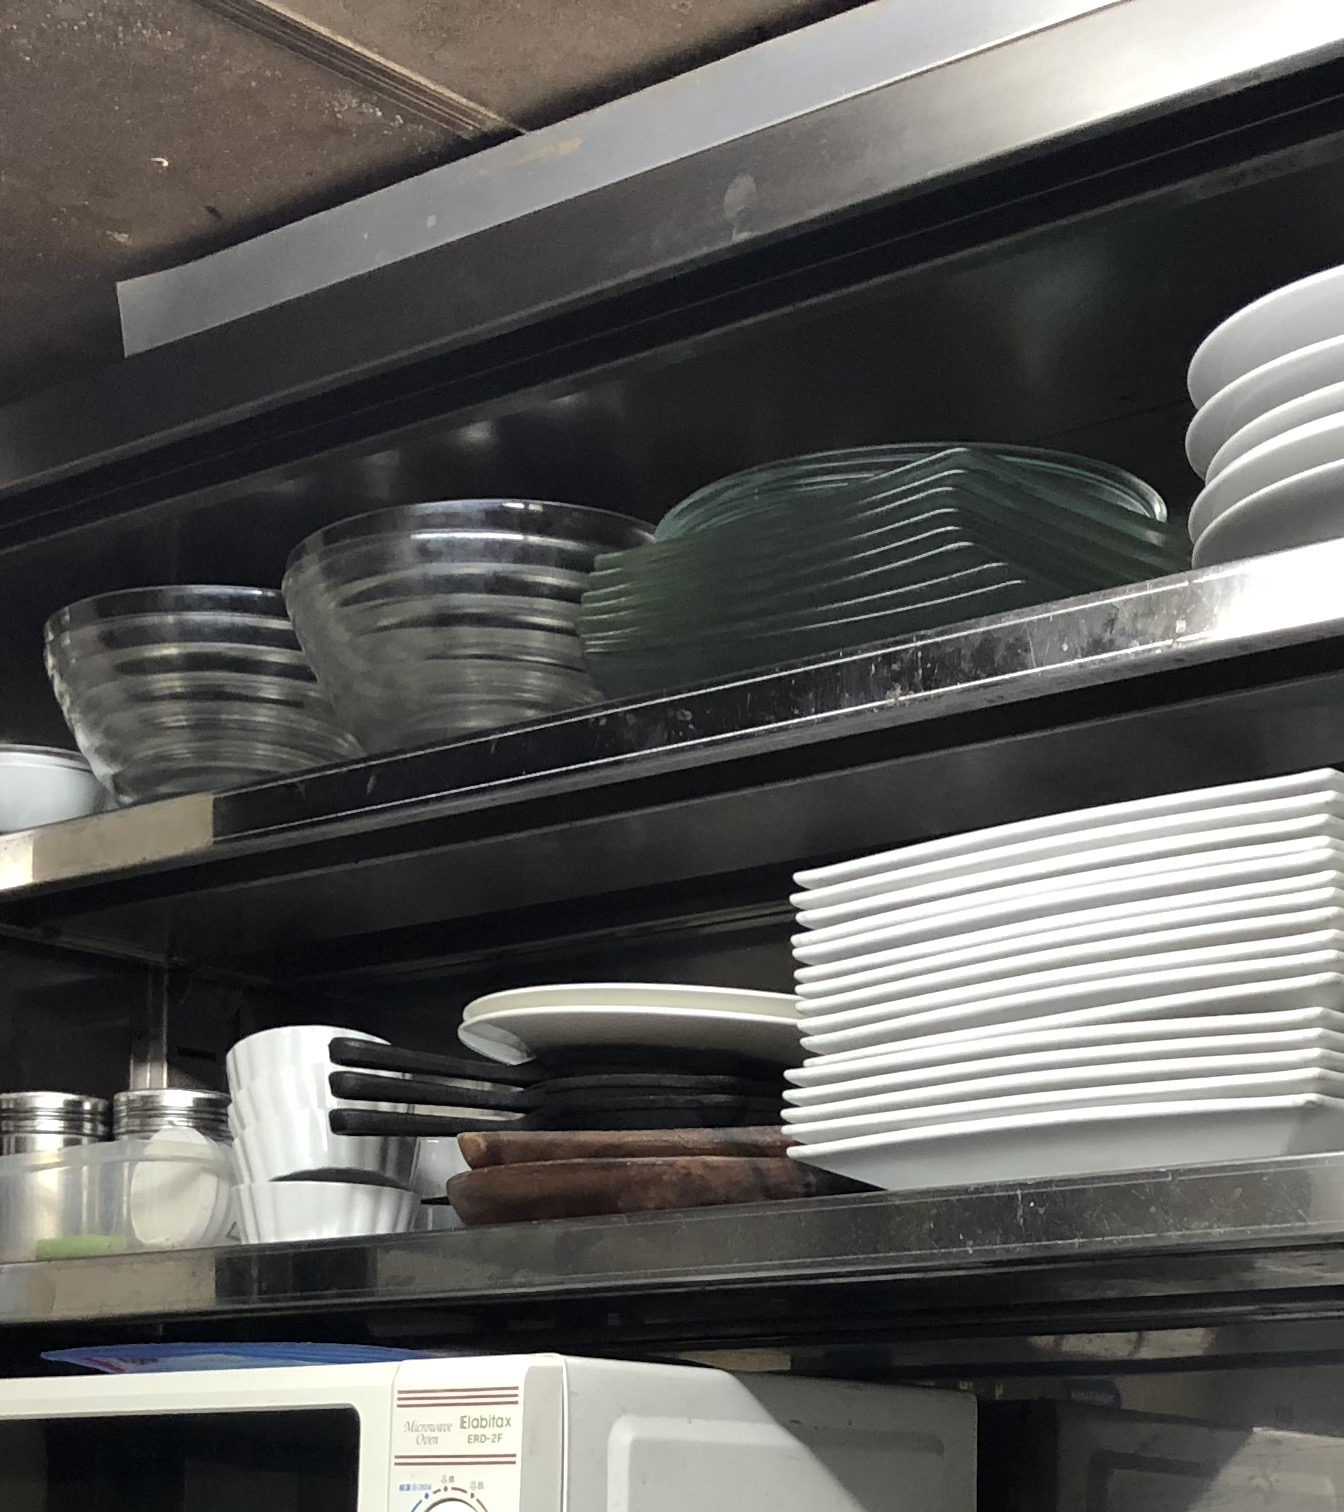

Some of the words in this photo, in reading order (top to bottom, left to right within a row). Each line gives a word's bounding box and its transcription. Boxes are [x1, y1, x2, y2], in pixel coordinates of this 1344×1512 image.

[404, 1420, 453, 1434] Microwave
[460, 1414, 511, 1430] Elabitax
[416, 1433, 439, 1446] Oven
[467, 1433, 503, 1444] ERD-2F
